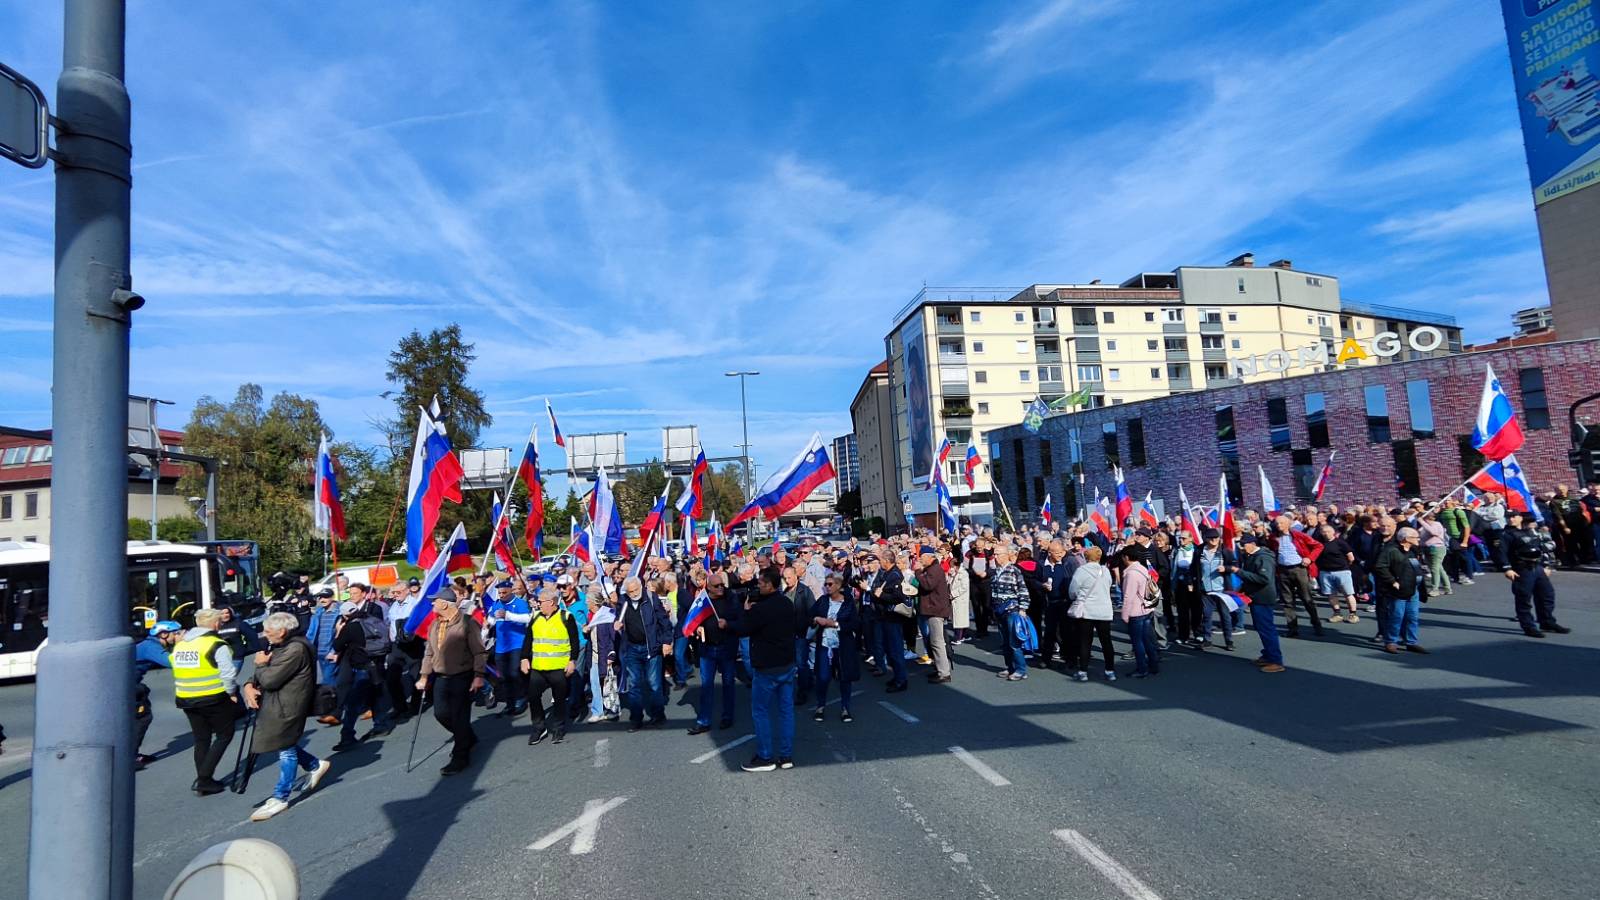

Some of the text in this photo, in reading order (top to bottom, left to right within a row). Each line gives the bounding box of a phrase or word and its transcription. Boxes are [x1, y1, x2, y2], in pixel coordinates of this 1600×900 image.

[1521, 31, 1529, 42] S
[1531, 0, 1592, 36] PLUSOM
[1523, 7, 1593, 53] NA DLANI
[1543, 20, 1595, 54] VEDNO
[1544, 170, 1600, 197] lidl.si/lidl-
[1231, 325, 1443, 379] NOMAGO
[175, 651, 199, 661] PRESS
